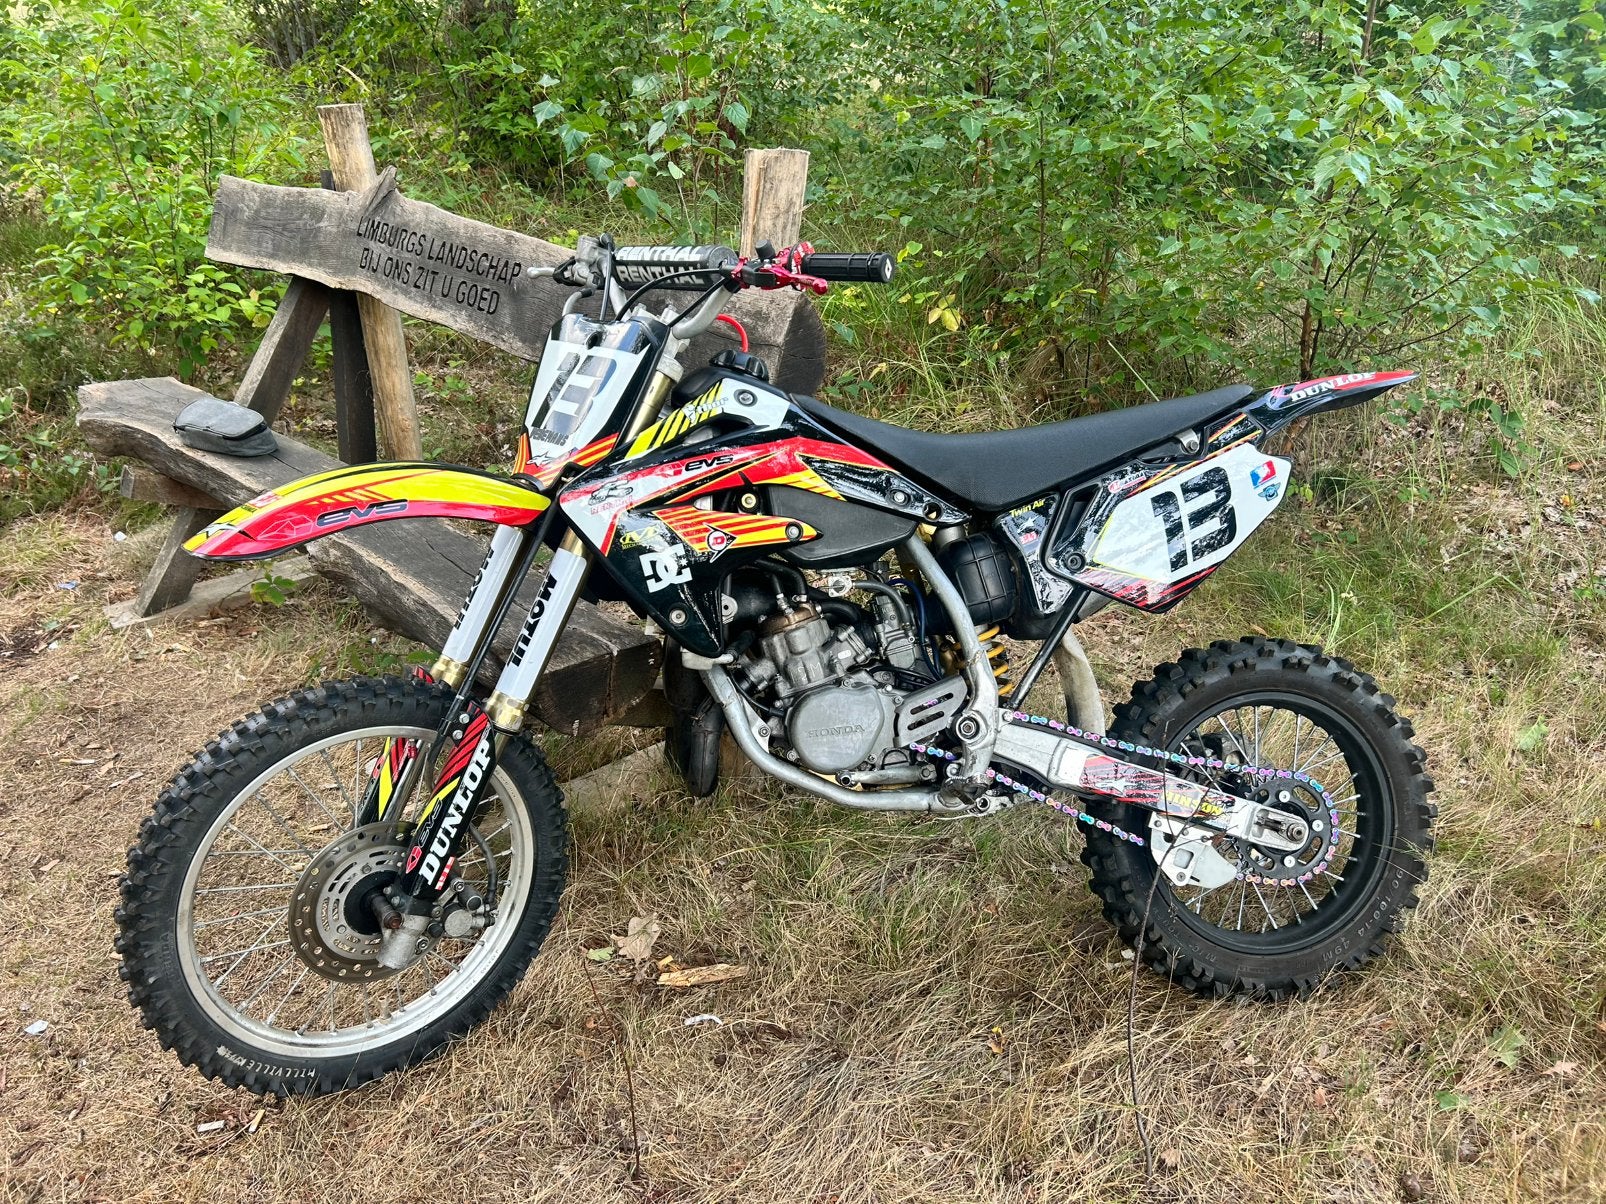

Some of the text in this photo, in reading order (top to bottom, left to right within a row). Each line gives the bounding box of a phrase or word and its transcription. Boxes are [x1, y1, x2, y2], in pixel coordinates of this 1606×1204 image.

[357, 217, 521, 286] LIMBURGS LANDSCHAP
[615, 246, 704, 262] RENTHAL
[360, 248, 500, 315] BIJ ONS ZIT U GOED
[615, 265, 706, 285] RENTHAL
[531, 352, 618, 435] 13
[684, 454, 735, 473] EVS
[316, 499, 408, 527] EVS
[1009, 498, 1047, 519] Twin Air
[1150, 466, 1237, 573] 13
[639, 545, 693, 592] DC
[507, 572, 558, 668] MOTUL
[807, 724, 866, 738] HONDA
[419, 740, 491, 885] DUNLOP
[246, 1060, 316, 1078] MILLVILLE
